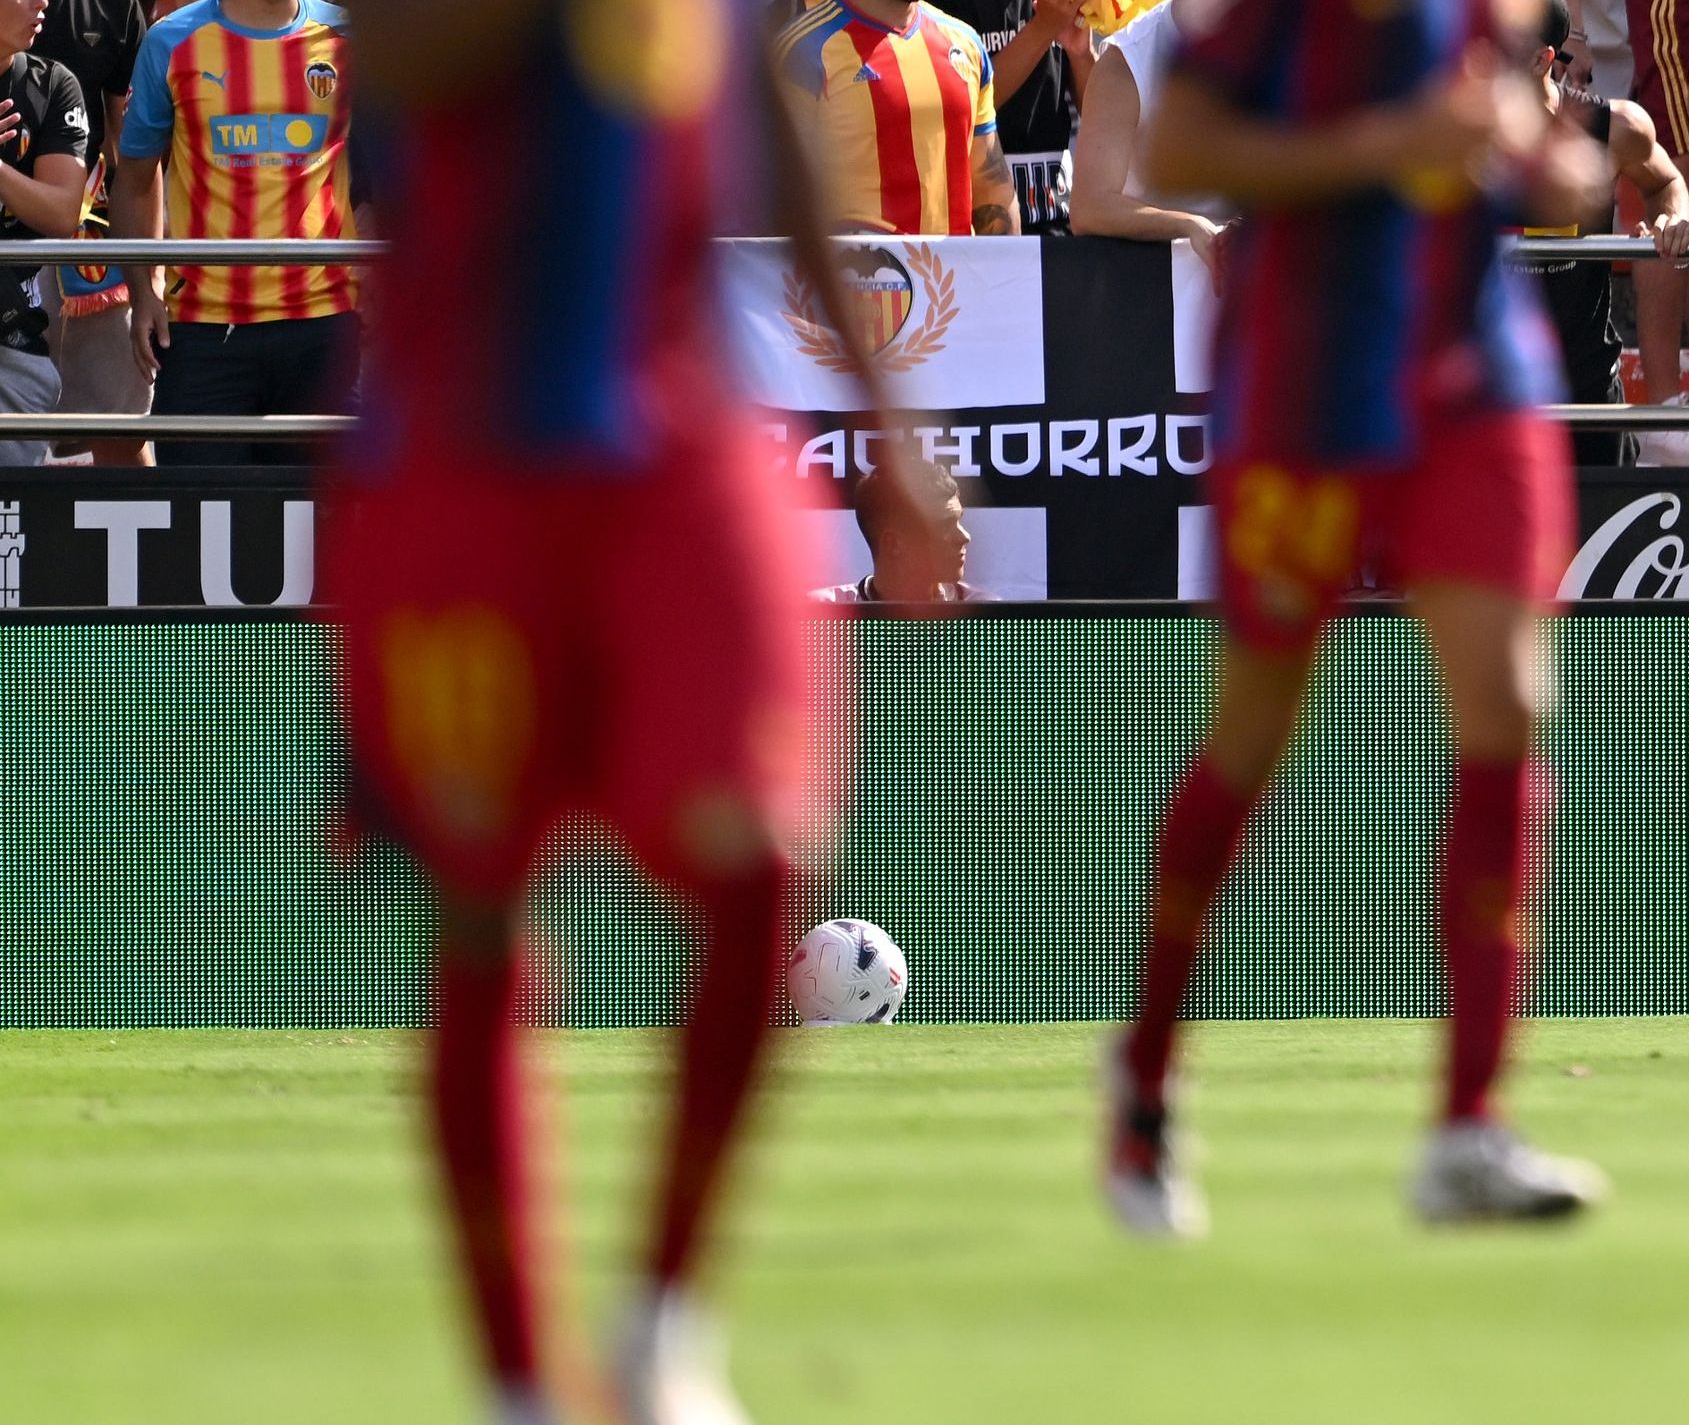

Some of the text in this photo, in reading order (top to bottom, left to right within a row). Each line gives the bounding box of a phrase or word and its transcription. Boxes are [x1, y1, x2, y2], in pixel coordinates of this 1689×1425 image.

[217, 124, 258, 147] TM
[232, 157, 255, 168] Real
[1513, 260, 1577, 274] Estate Group
